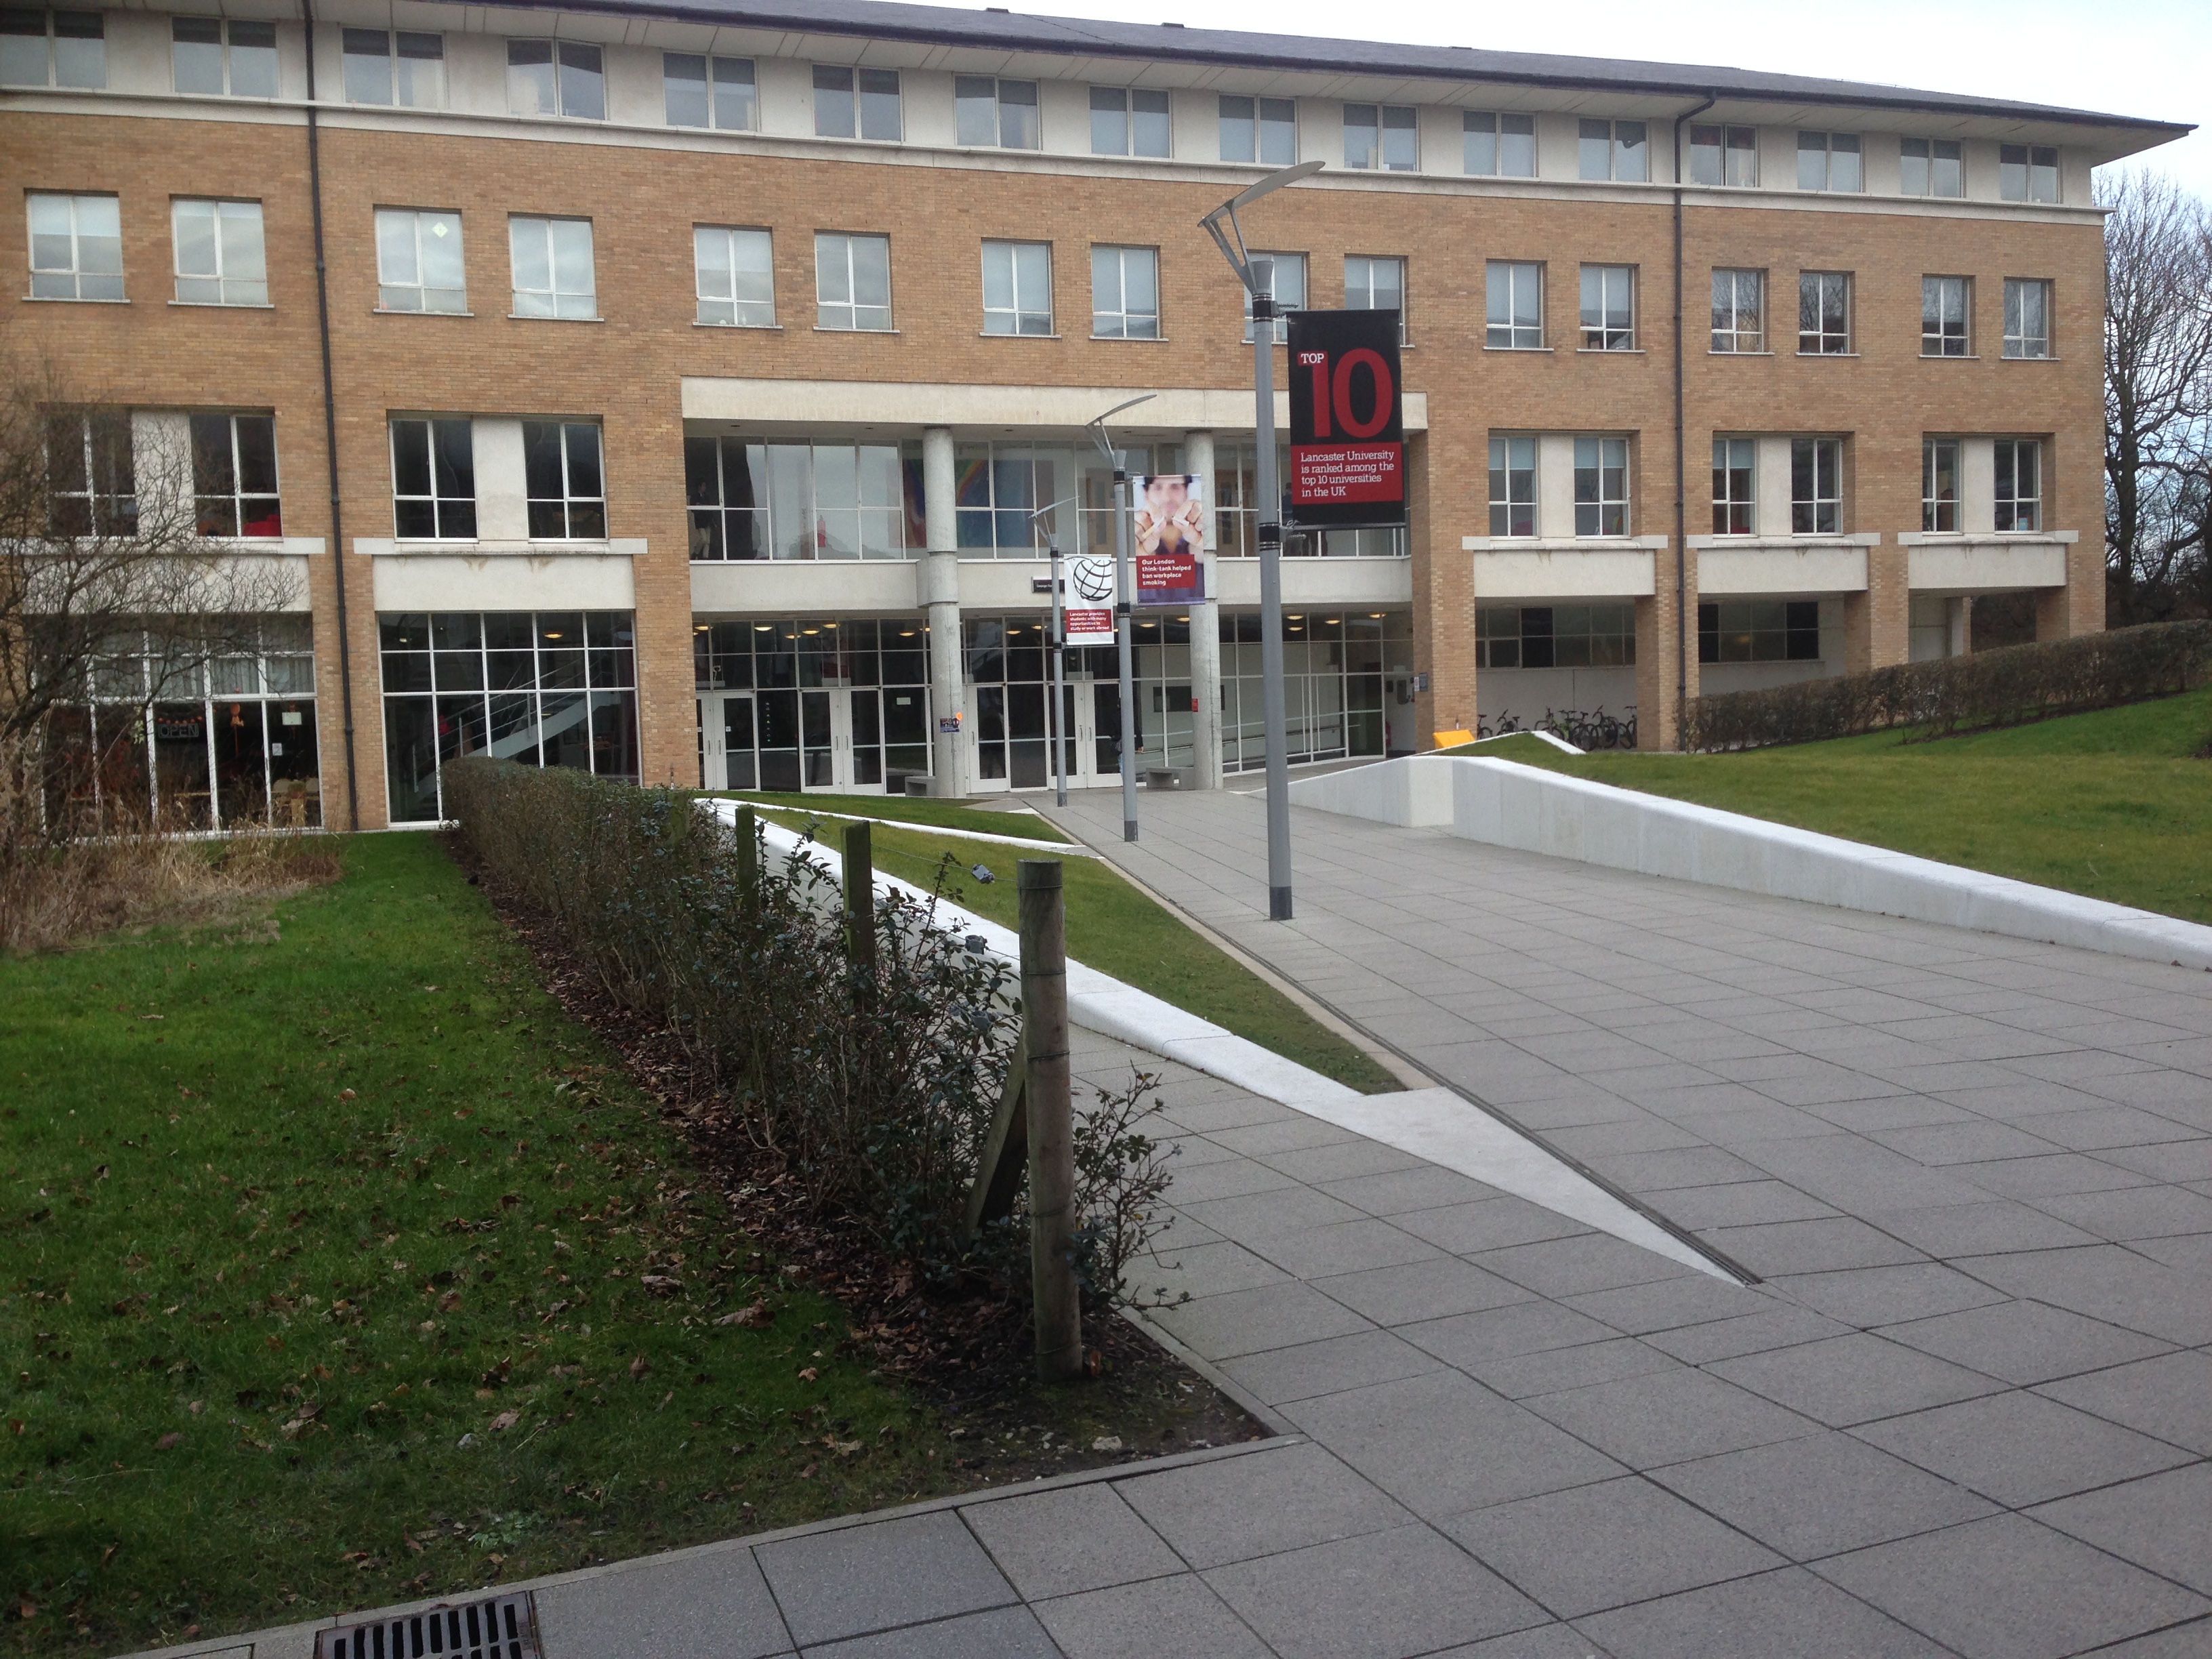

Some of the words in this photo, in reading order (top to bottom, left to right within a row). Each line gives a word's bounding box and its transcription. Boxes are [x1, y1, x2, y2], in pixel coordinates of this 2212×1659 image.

[1300, 353, 1325, 364] TOP
[1298, 347, 1393, 438] 10
[1300, 452, 1345, 462] Lancaster
[1347, 450, 1395, 461] University
[1301, 464, 1309, 474] is
[1311, 463, 1343, 473] ranked
[1345, 463, 1377, 472] among
[1379, 461, 1395, 470] the
[1301, 475, 1316, 486] top
[1317, 475, 1328, 485] 10
[1329, 474, 1382, 484] universities
[1302, 487, 1312, 497] in
[1313, 487, 1329, 497] the
[1330, 486, 1347, 496] UK
[161, 724, 199, 737] OPEN
